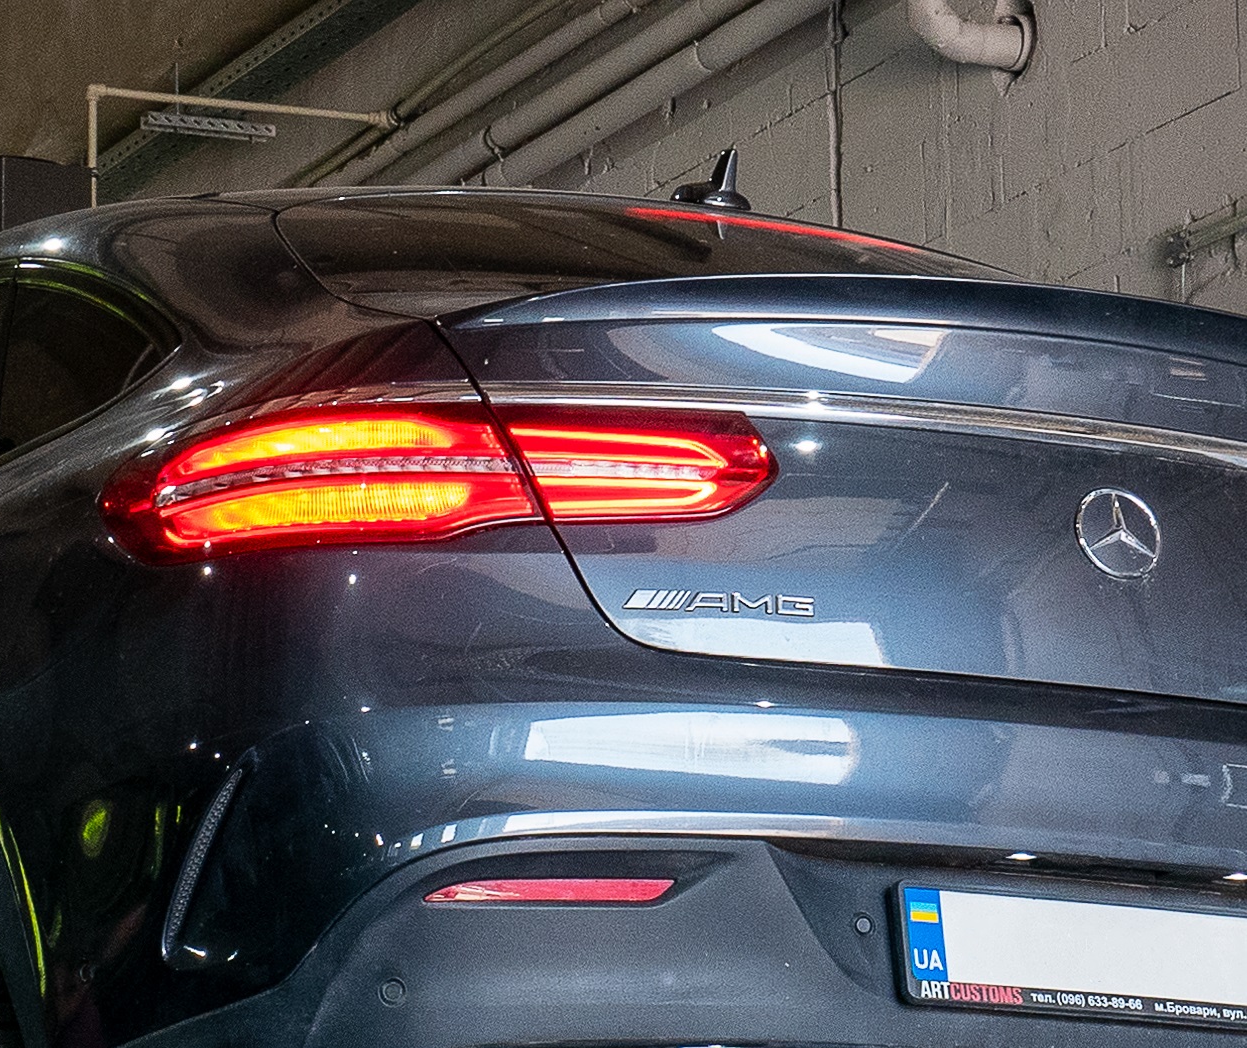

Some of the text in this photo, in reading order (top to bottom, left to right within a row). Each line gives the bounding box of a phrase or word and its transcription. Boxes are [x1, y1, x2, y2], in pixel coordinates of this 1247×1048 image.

[683, 591, 815, 617] AMG
[914, 947, 944, 971] UA
[920, 980, 1024, 1005] ARTCUSTOMS
[1057, 991, 1086, 1008] (096)
[1087, 995, 1144, 1011] 633-89-66
